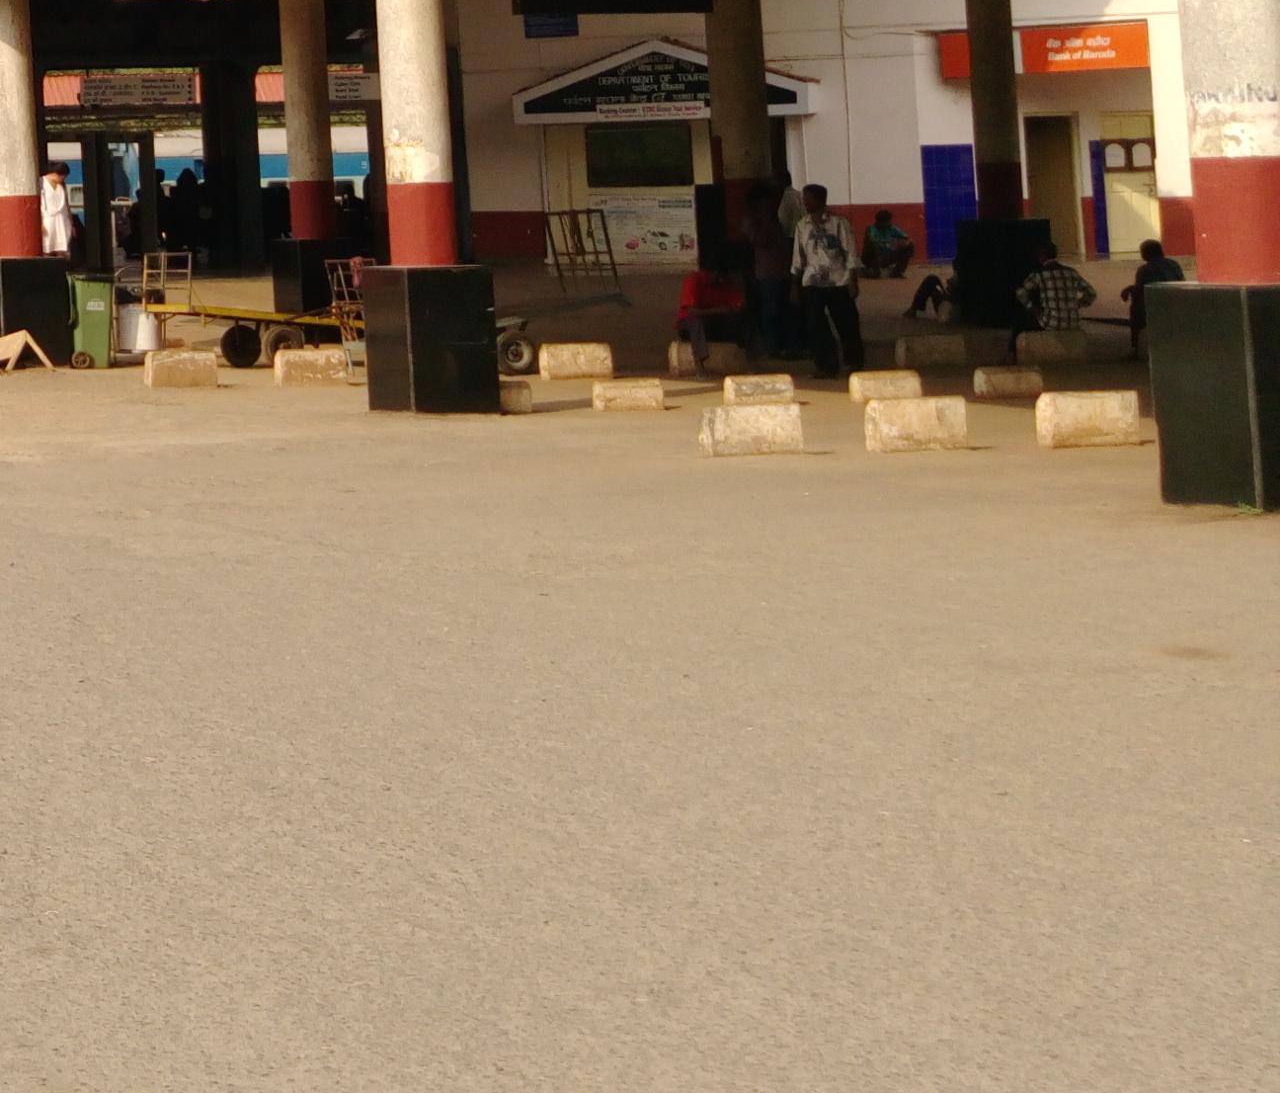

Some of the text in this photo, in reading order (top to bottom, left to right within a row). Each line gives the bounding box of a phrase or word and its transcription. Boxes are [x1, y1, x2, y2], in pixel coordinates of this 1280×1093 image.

[1047, 50, 1071, 61] Bank
[598, 73, 710, 85] DEPARTMENT OF TOURIS
